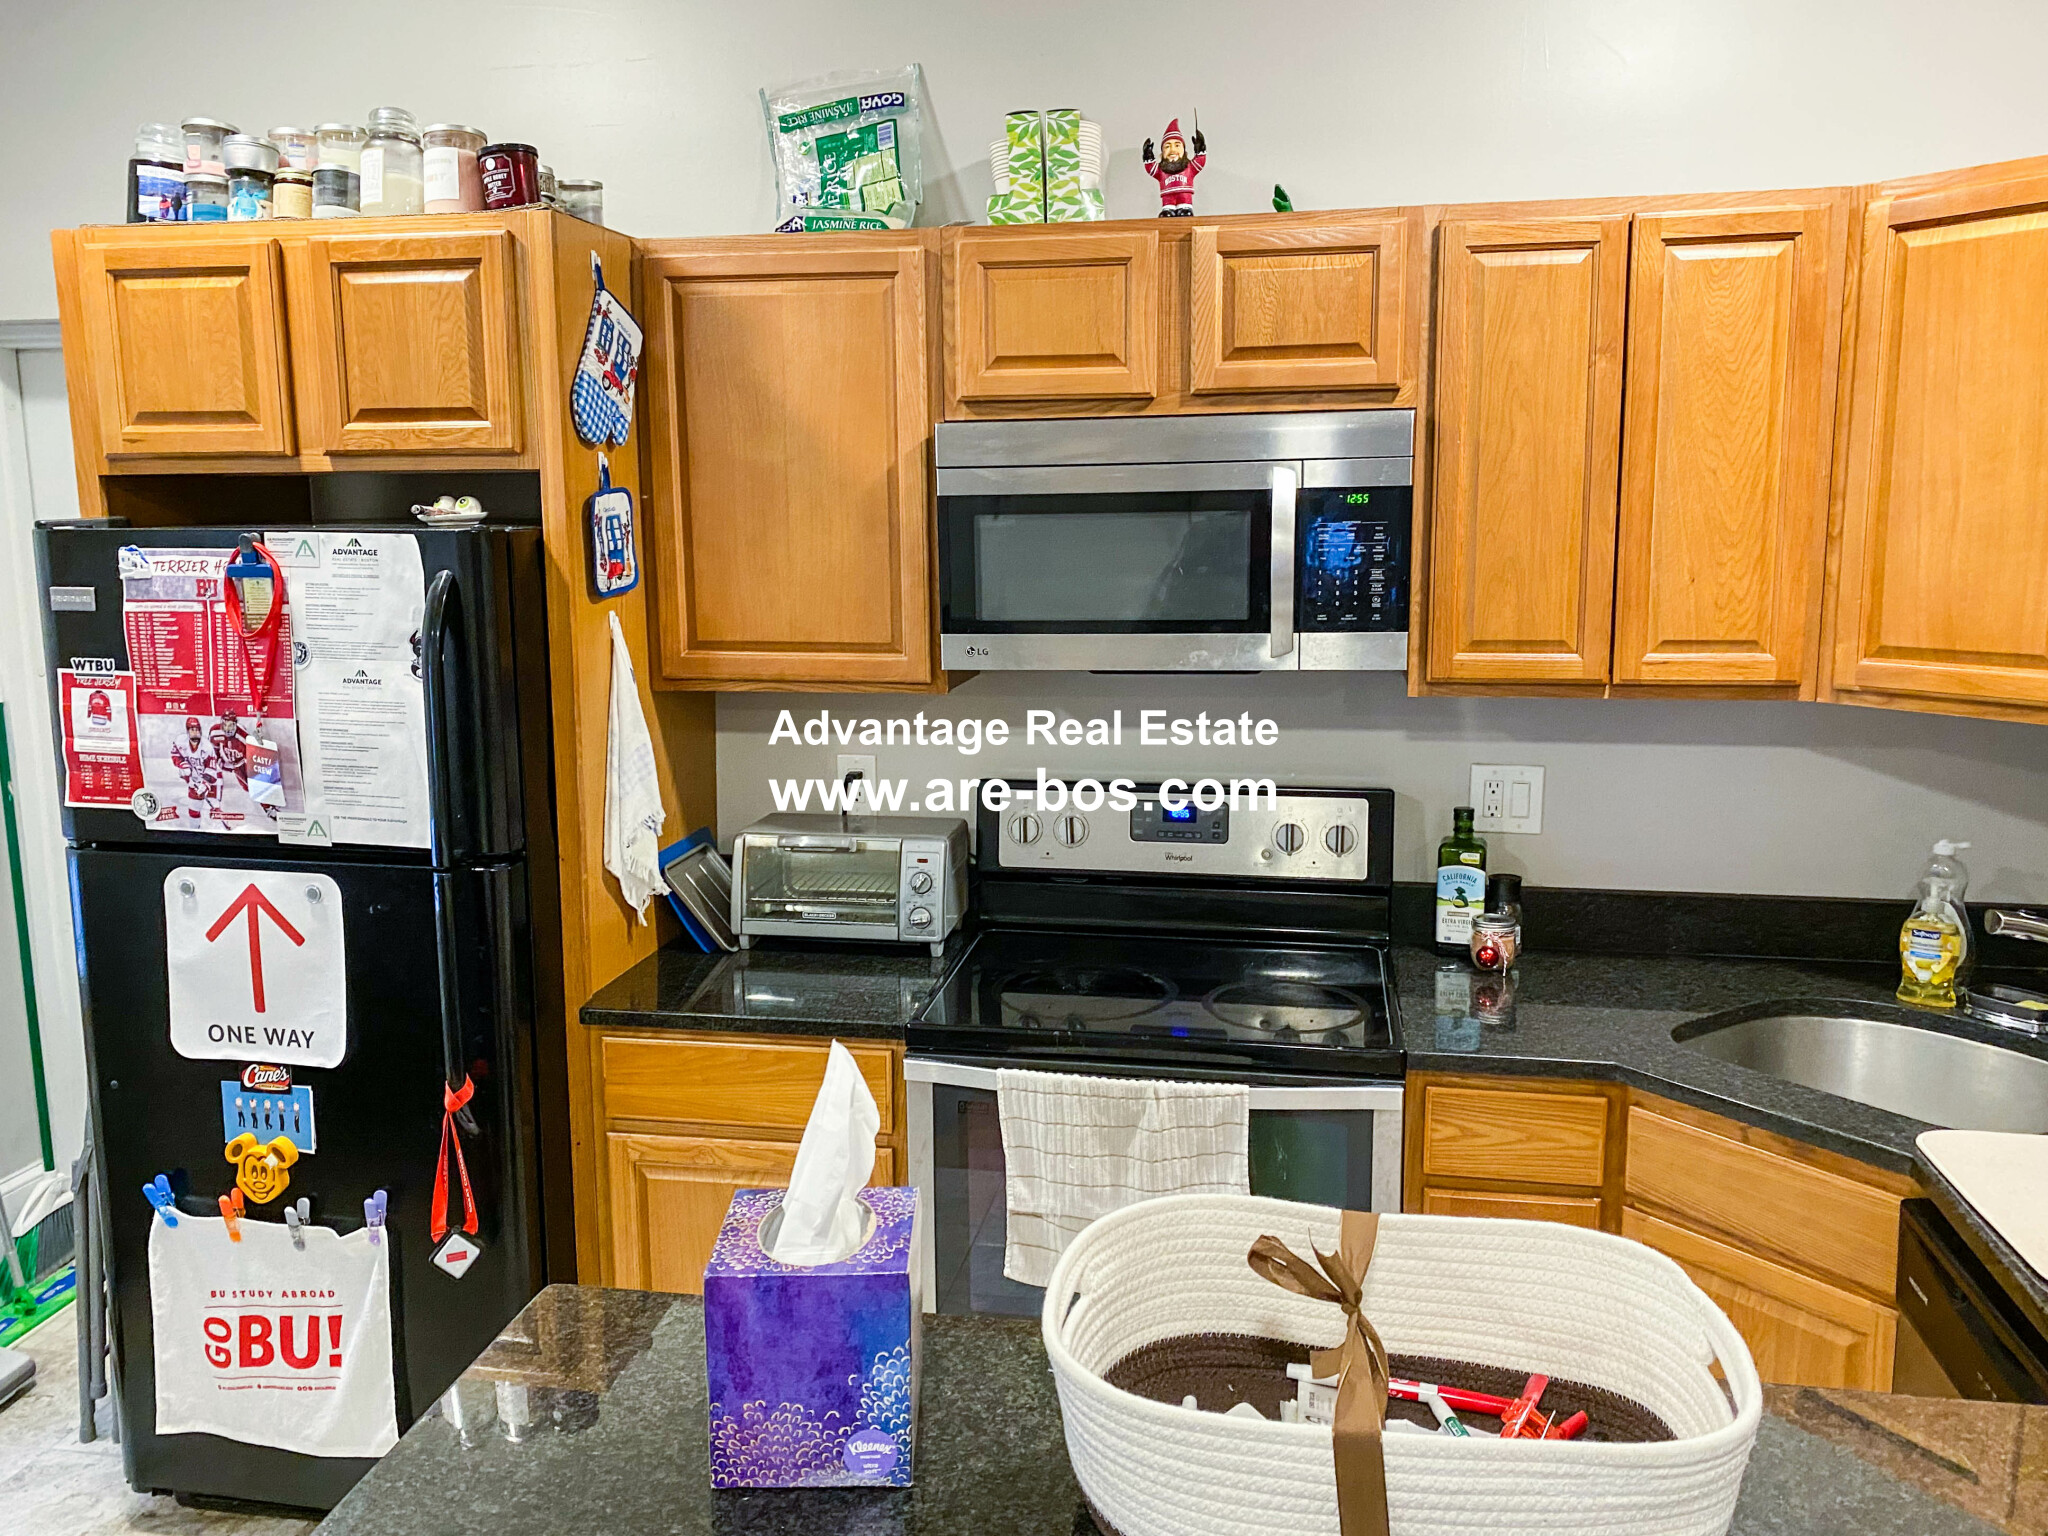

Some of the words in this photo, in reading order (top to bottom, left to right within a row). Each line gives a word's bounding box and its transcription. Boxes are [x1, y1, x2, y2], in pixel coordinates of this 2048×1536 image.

[861, 93, 903, 109] GOYA
[809, 102, 851, 121] JASMINE
[787, 114, 807, 126] RICE
[812, 219, 857, 230] JASMINE
[860, 221, 882, 230] RICE
[332, 548, 378, 556] ADVANTAGE
[152, 560, 209, 574] TERRIER
[196, 579, 218, 598] BU
[977, 647, 989, 656] LG
[73, 660, 113, 671] WTBU
[252, 755, 271, 765] CAST/
[253, 765, 273, 776] CREW
[1165, 853, 1192, 862] Whirlpool
[1442, 873, 1478, 884] CALIFORNIA
[208, 1024, 257, 1045] ONE
[263, 1027, 315, 1049] WAY
[243, 1064, 290, 1088] Cane's
[210, 1290, 226, 1298] BU
[232, 1290, 273, 1298] STUDY
[281, 1290, 335, 1298] ABROAD
[203, 1317, 232, 1369] GO
[239, 1315, 343, 1370] BU!
[848, 1441, 893, 1455] Kleenex
